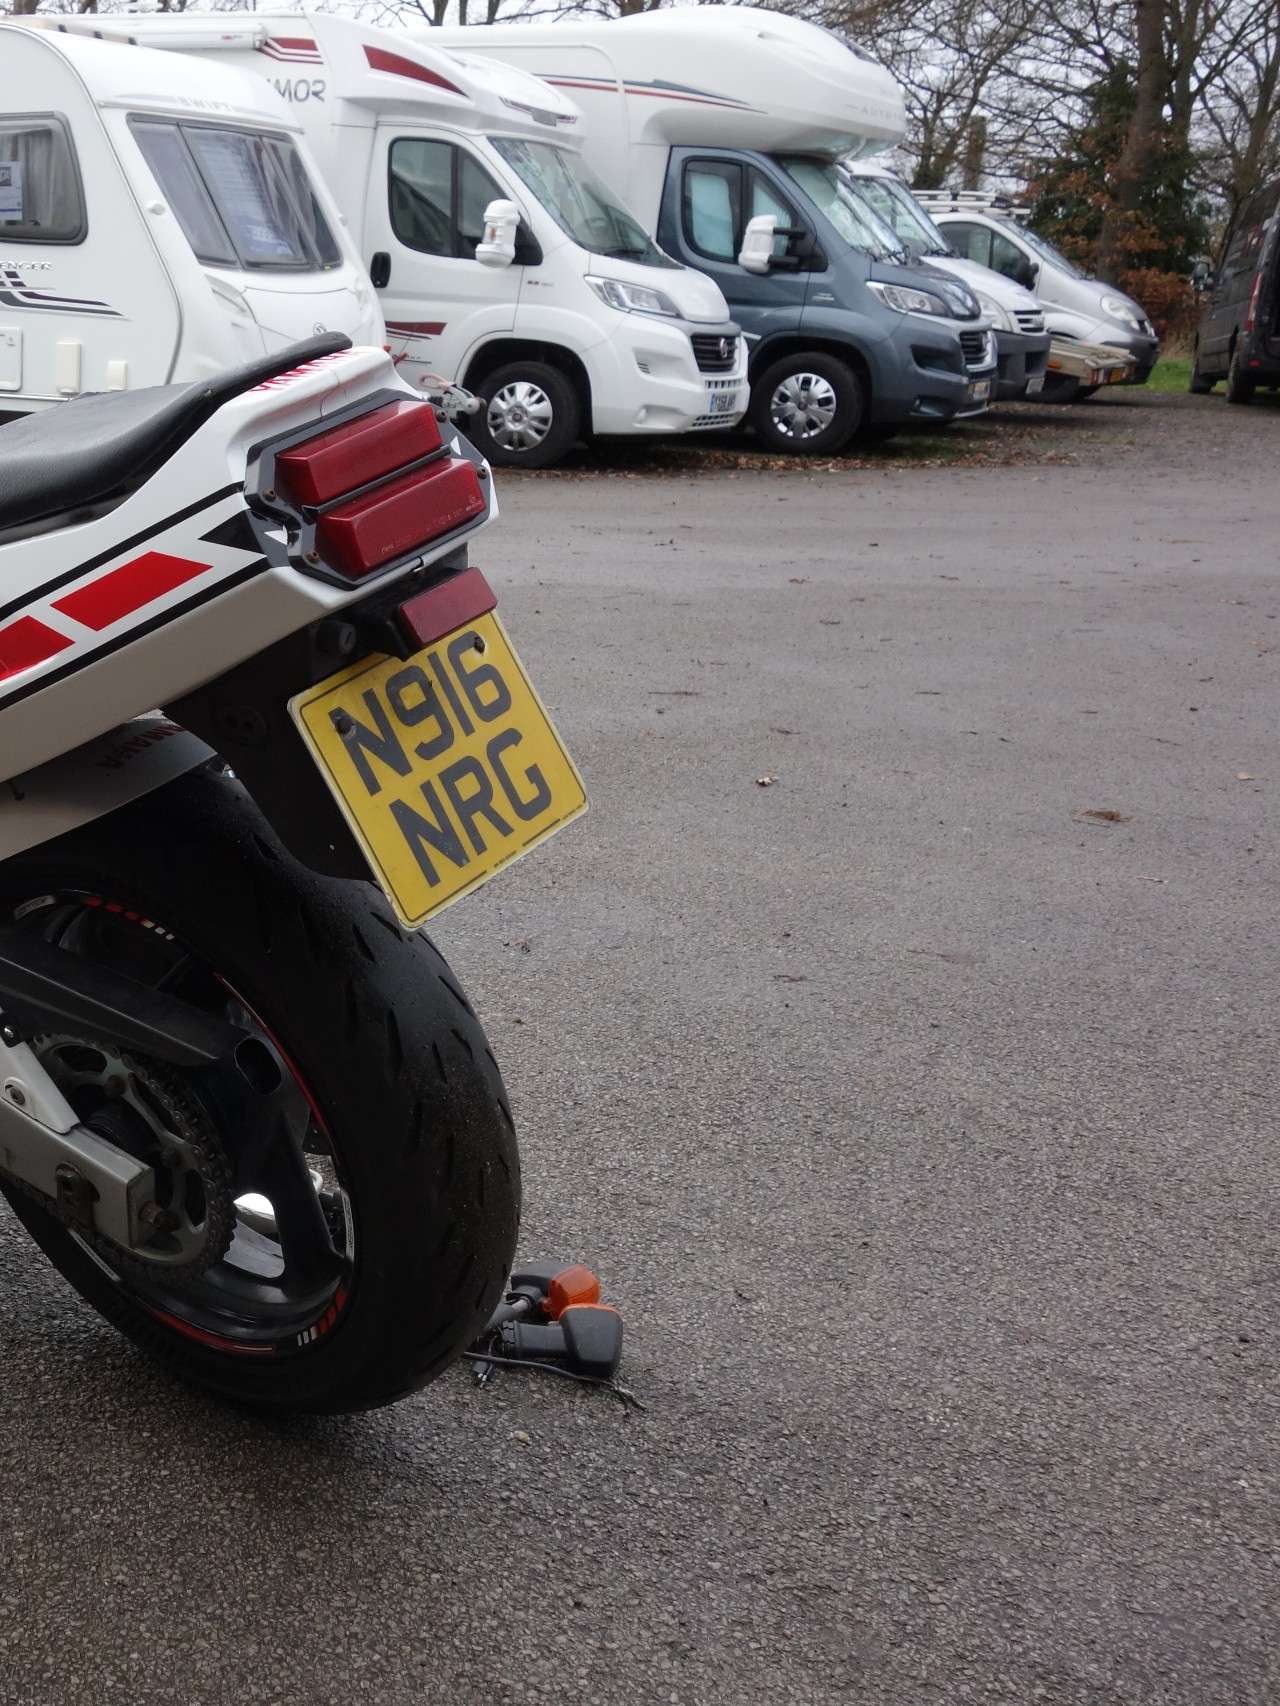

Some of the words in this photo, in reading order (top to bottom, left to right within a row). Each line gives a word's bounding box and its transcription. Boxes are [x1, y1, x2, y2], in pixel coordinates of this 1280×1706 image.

[267, 78, 326, 103] MOR
[328, 630, 512, 797] N916
[388, 727, 552, 888] NRG
